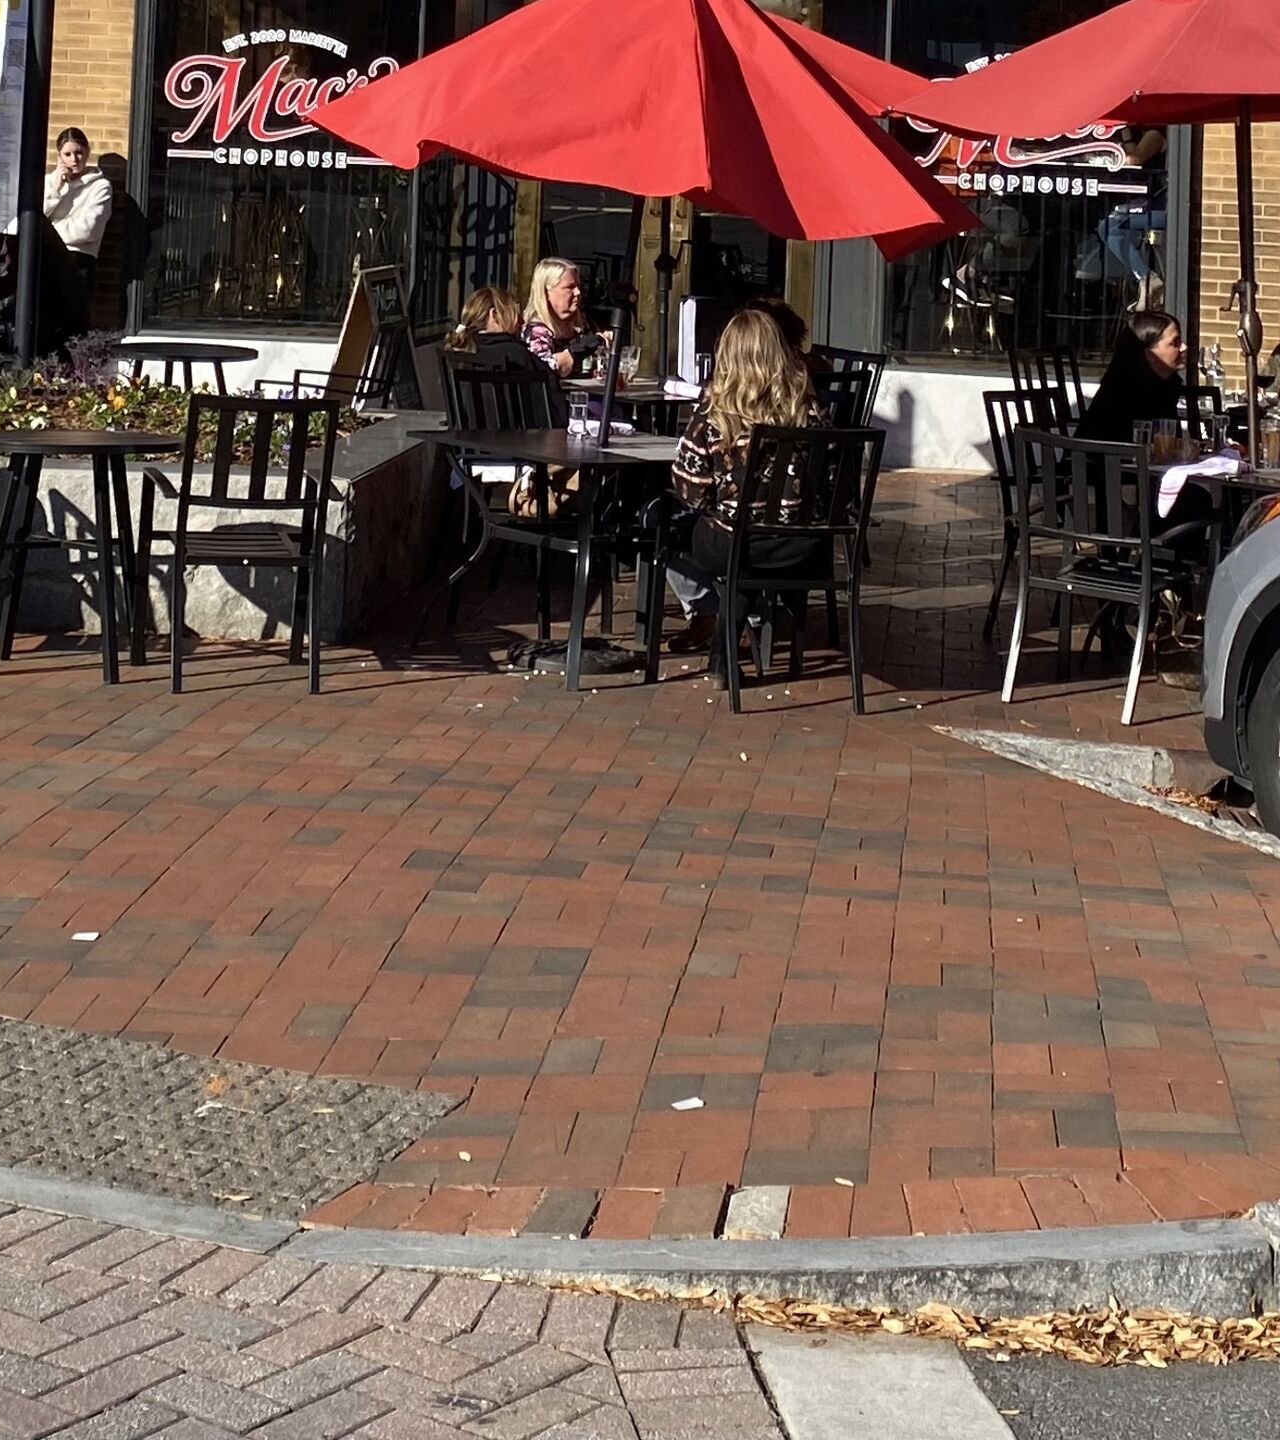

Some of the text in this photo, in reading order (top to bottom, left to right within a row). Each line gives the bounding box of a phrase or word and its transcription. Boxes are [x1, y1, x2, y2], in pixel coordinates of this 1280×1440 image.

[222, 29, 348, 58] EST. 2020 MARIETTA
[213, 147, 348, 169] CHOPHOUSE
[957, 173, 1099, 196] CHOPHOUSE
